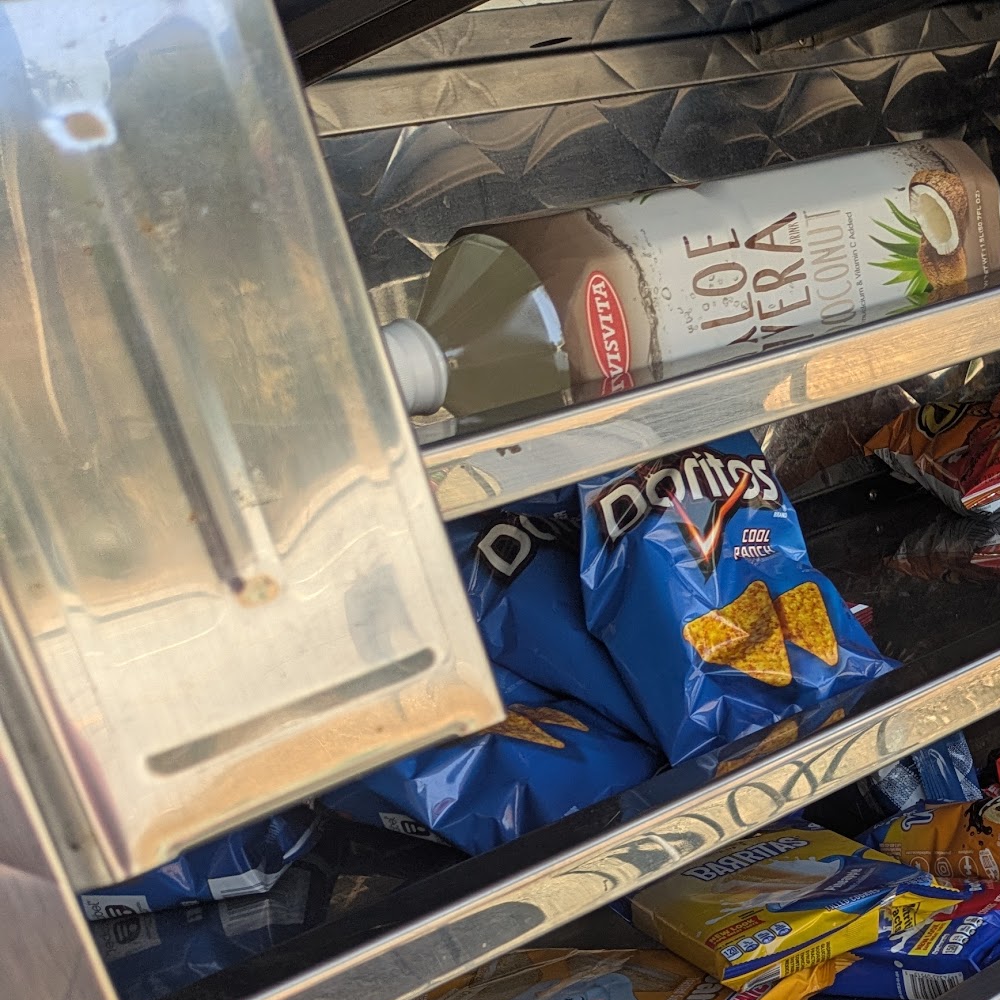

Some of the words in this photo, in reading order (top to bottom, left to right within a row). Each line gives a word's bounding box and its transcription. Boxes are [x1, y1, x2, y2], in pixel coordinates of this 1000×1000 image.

[600, 452, 780, 541] Doritos
[742, 528, 772, 544] COOL
[709, 929, 727, 945] NEW
[722, 946, 738, 957] 120
